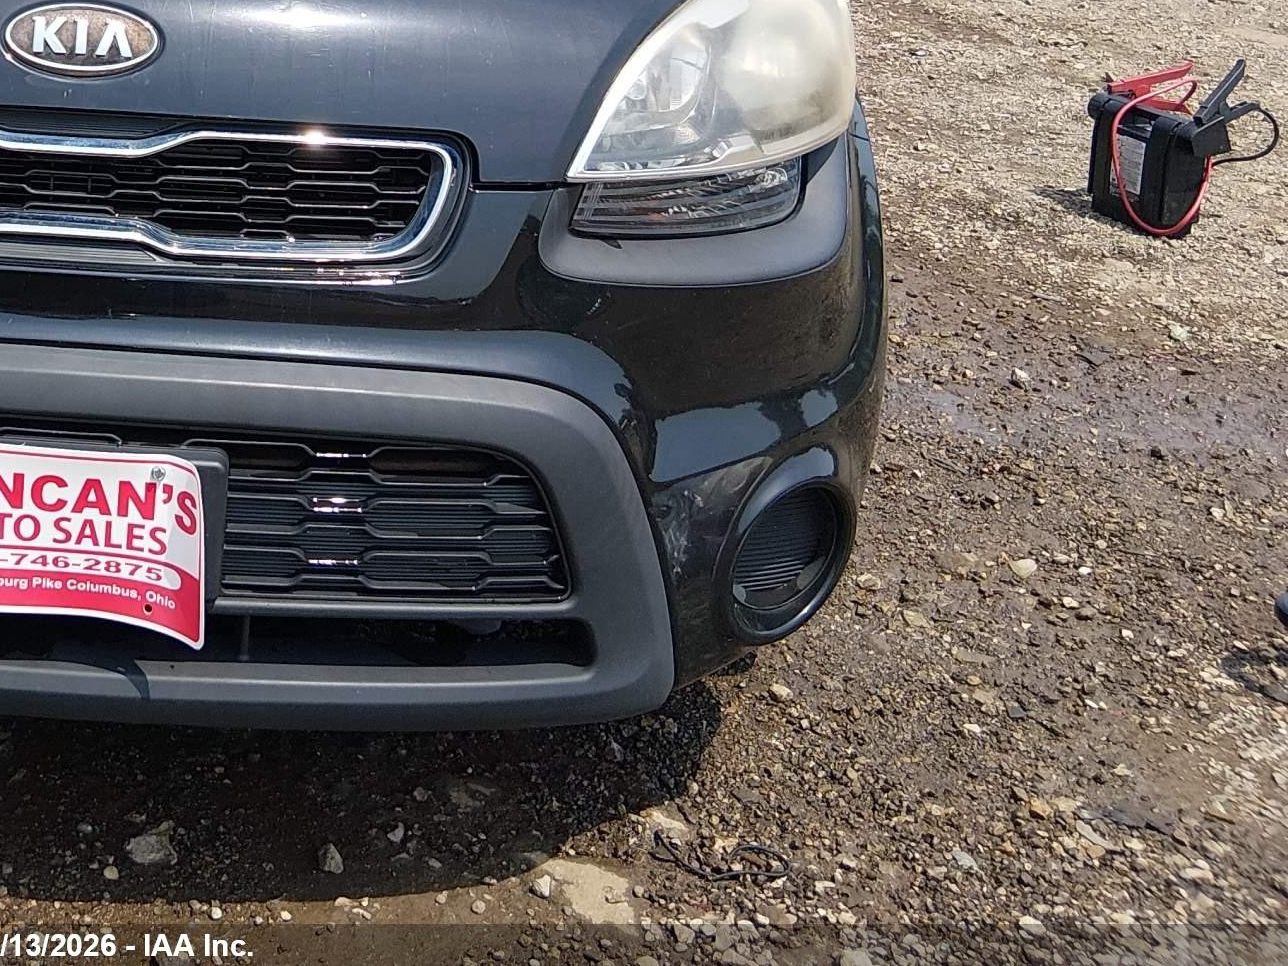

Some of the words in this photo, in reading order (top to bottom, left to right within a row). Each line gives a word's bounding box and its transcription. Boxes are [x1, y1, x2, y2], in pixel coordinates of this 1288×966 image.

[32, 16, 133, 58] KIA
[53, 516, 168, 556] SALES
[32, 578, 62, 592] Pike
[66, 579, 142, 601] Columbus,
[146, 590, 176, 609] Ohio
